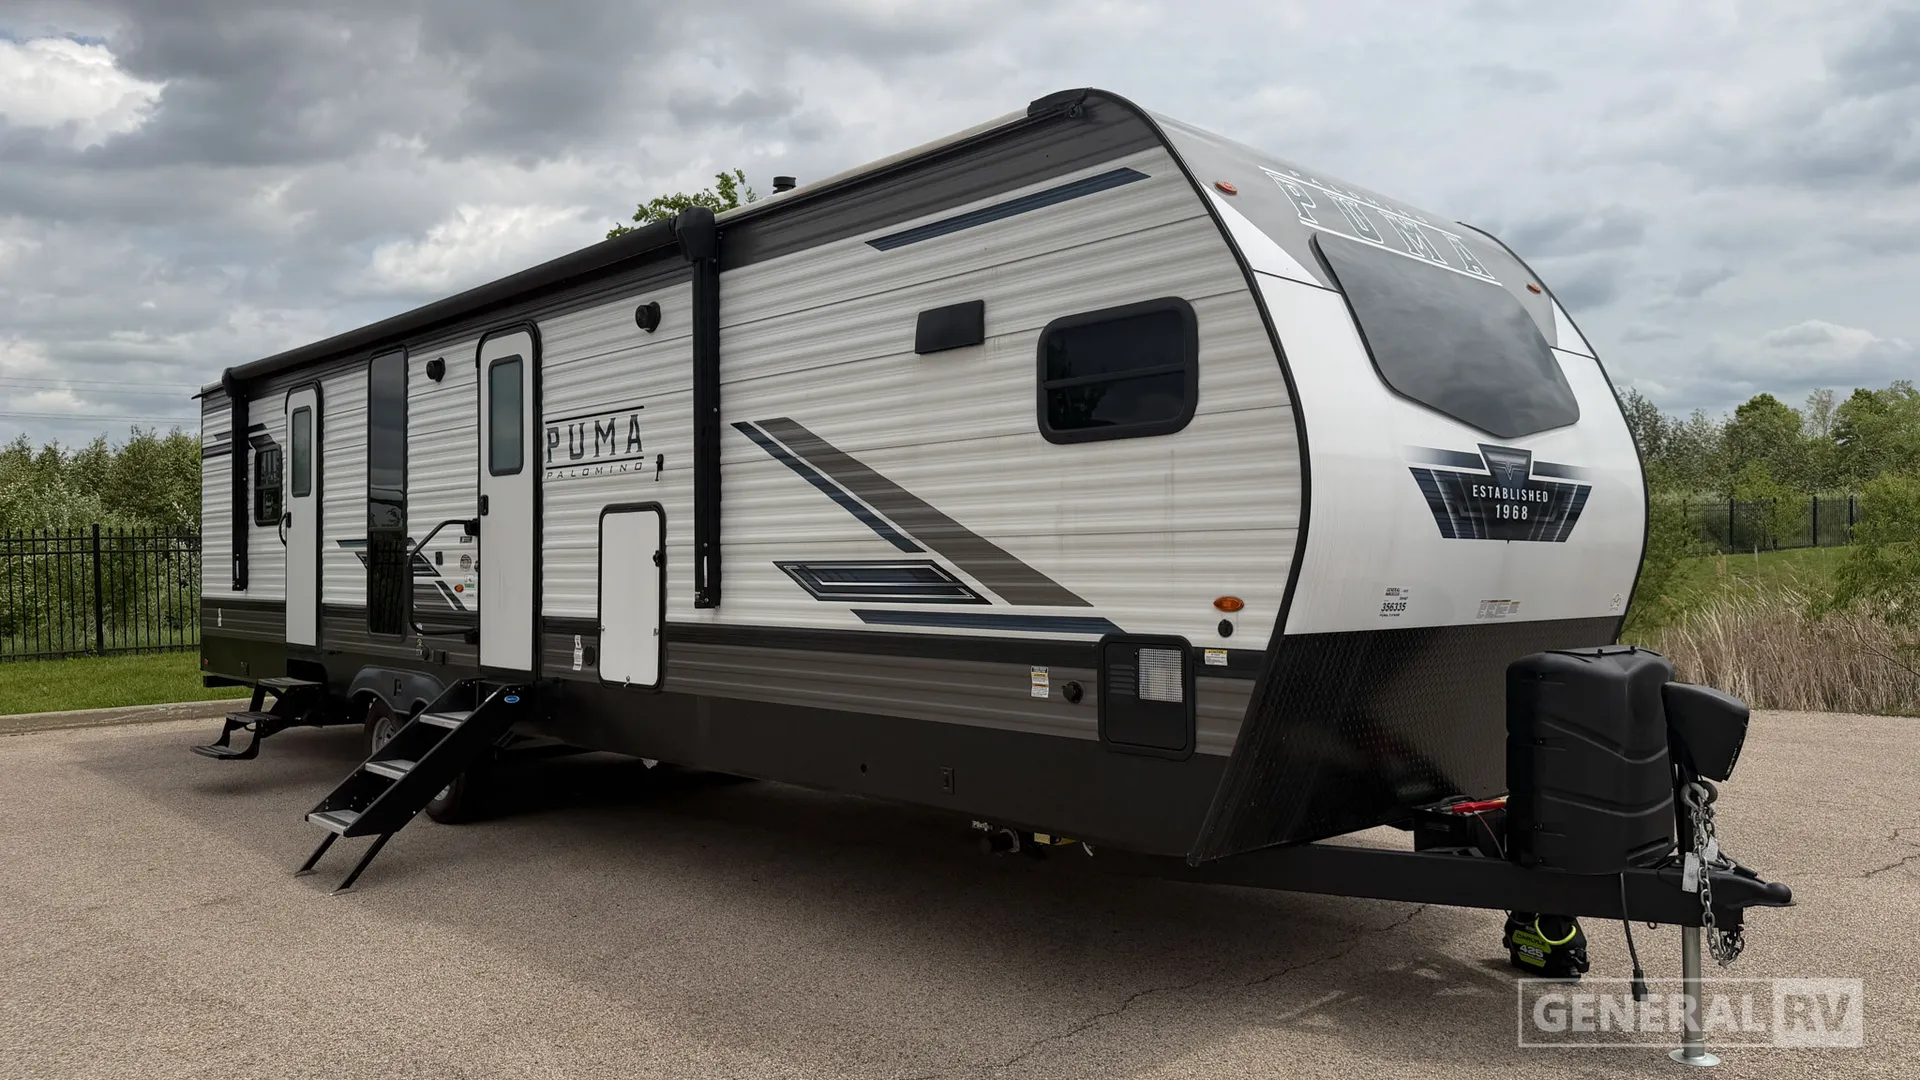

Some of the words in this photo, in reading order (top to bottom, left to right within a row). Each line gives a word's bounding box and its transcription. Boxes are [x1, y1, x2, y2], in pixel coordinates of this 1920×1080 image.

[1265, 171, 1496, 280] PUMA
[546, 413, 643, 463] PUMA
[546, 462, 643, 479] PALOMINO
[1472, 484, 1549, 503] ESTABLISHED
[1495, 504, 1528, 520] 1968
[1519, 944, 1544, 958] 425
